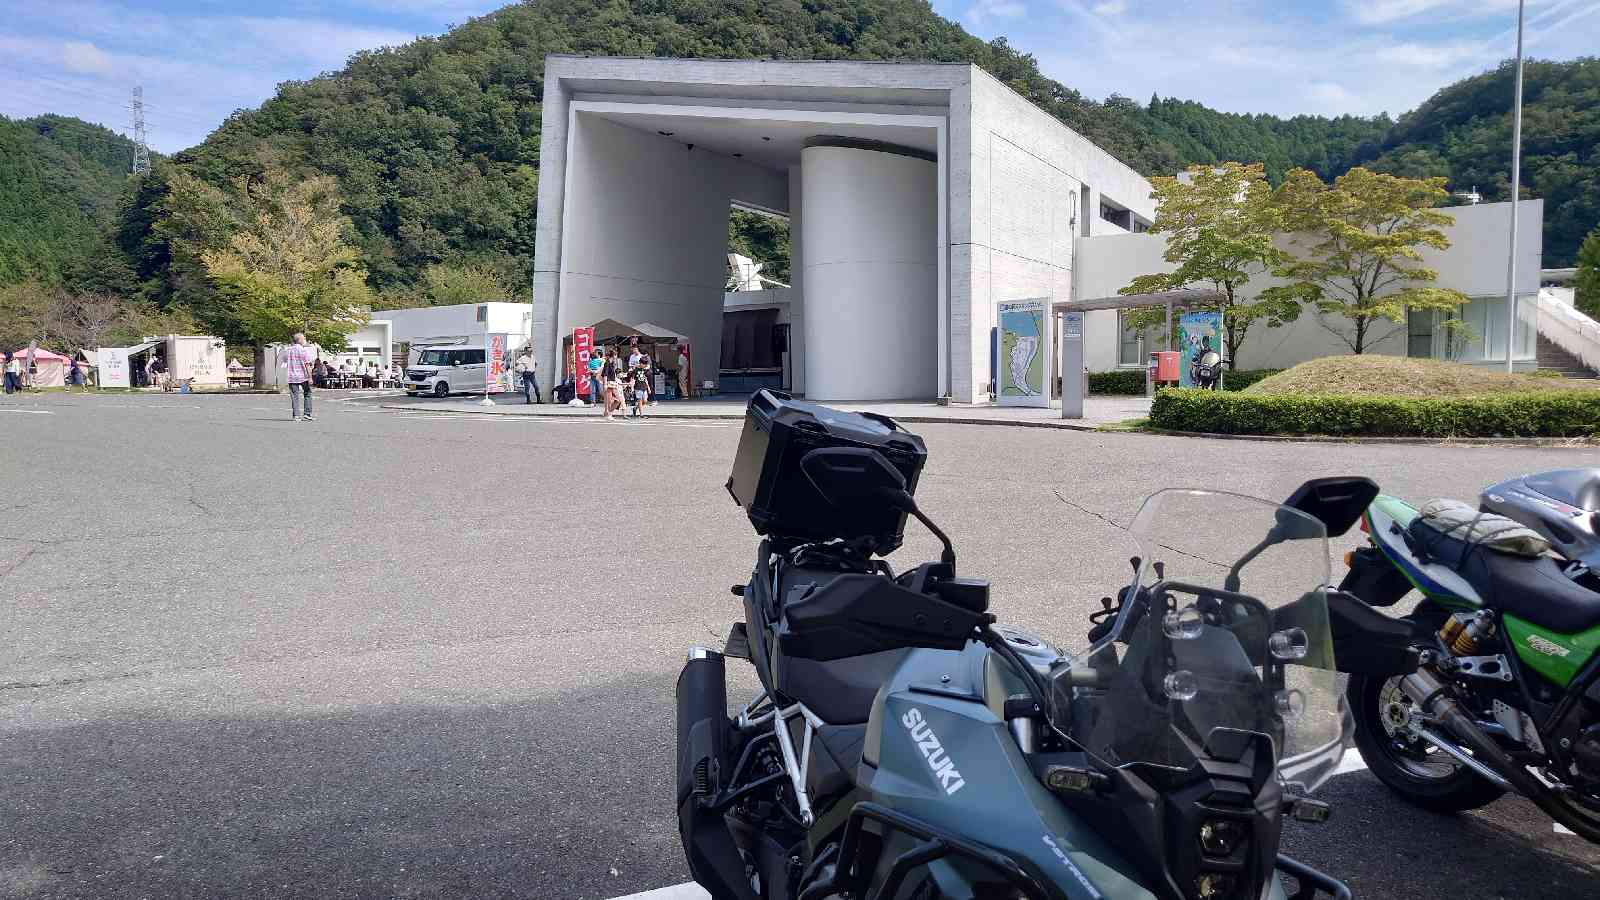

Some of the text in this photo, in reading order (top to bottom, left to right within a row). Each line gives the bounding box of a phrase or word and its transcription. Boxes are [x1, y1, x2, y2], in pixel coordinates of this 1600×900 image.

[490, 335, 505, 375] かき氷
[902, 707, 966, 796] SUZUKI
